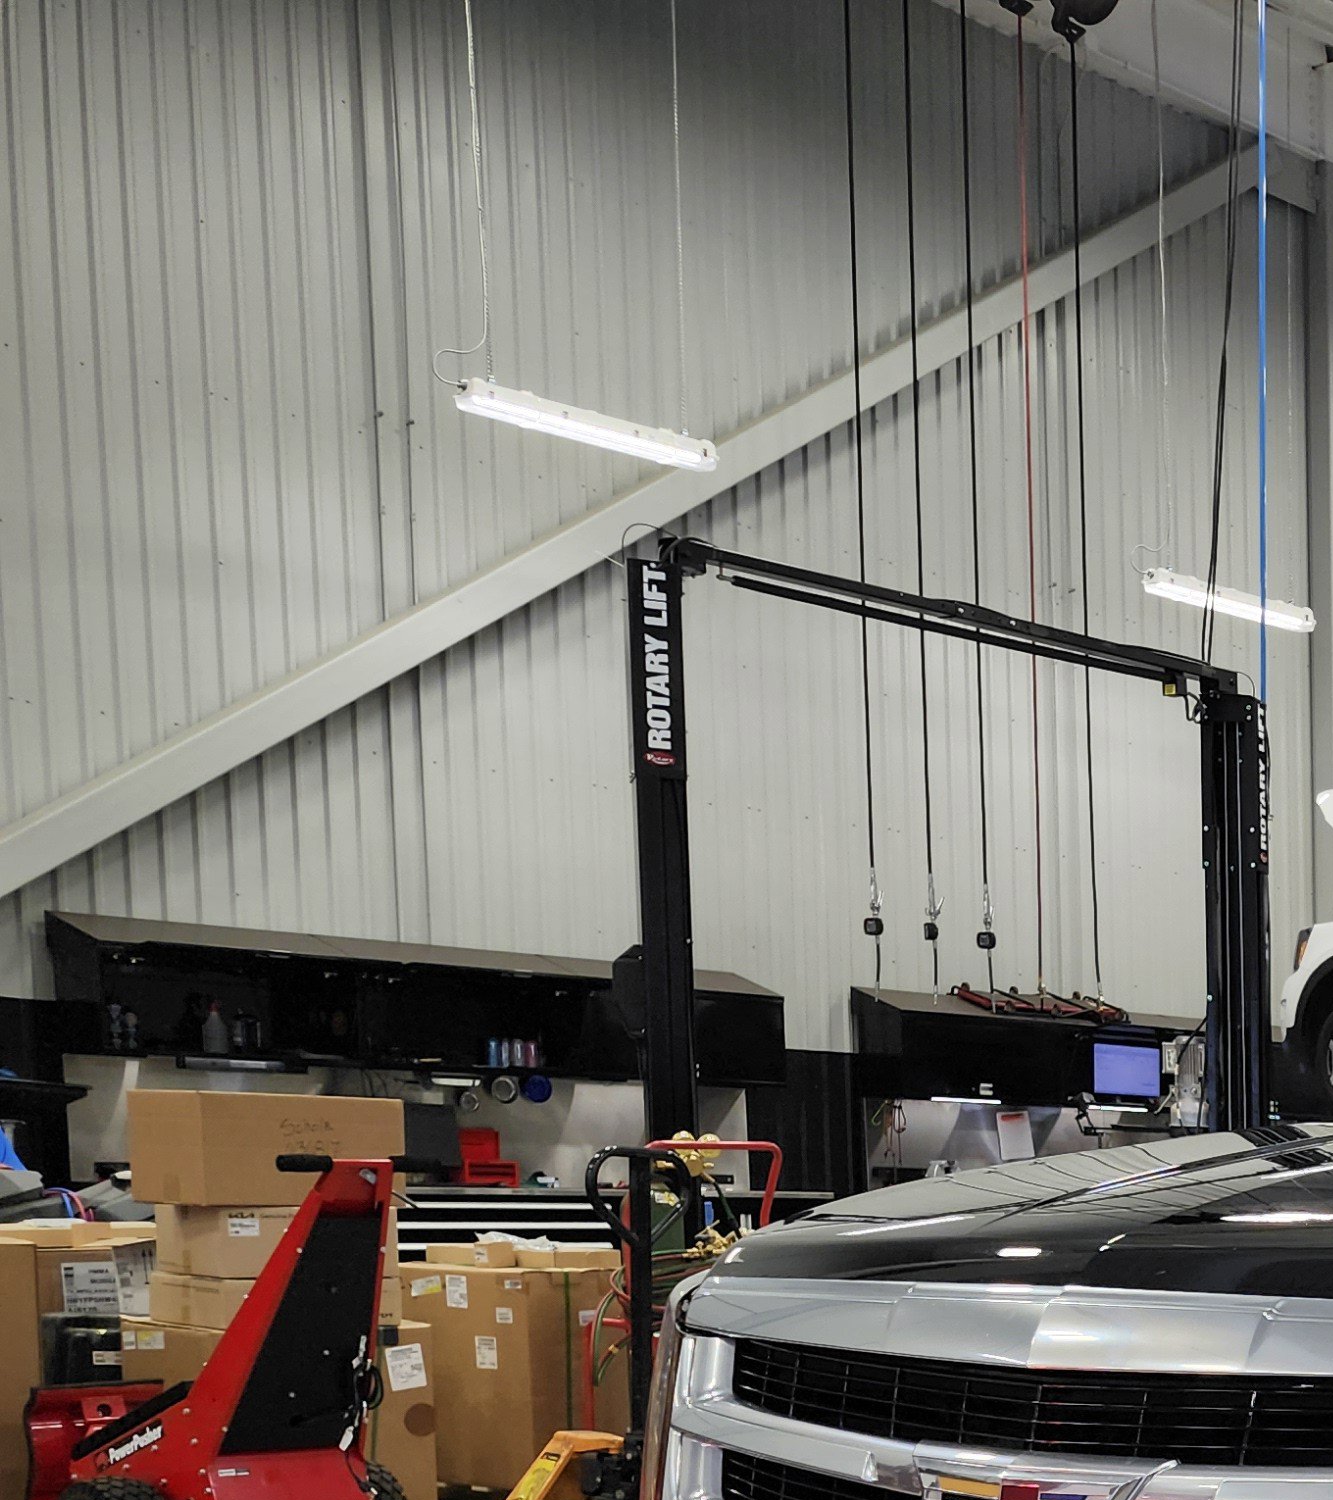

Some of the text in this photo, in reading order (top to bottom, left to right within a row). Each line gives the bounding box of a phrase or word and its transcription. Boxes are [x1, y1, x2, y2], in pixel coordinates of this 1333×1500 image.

[642, 563, 668, 627] LIFT
[644, 632, 672, 750] ROTARY
[1257, 703, 1266, 753] LIFT
[1258, 757, 1268, 850] ROTARY
